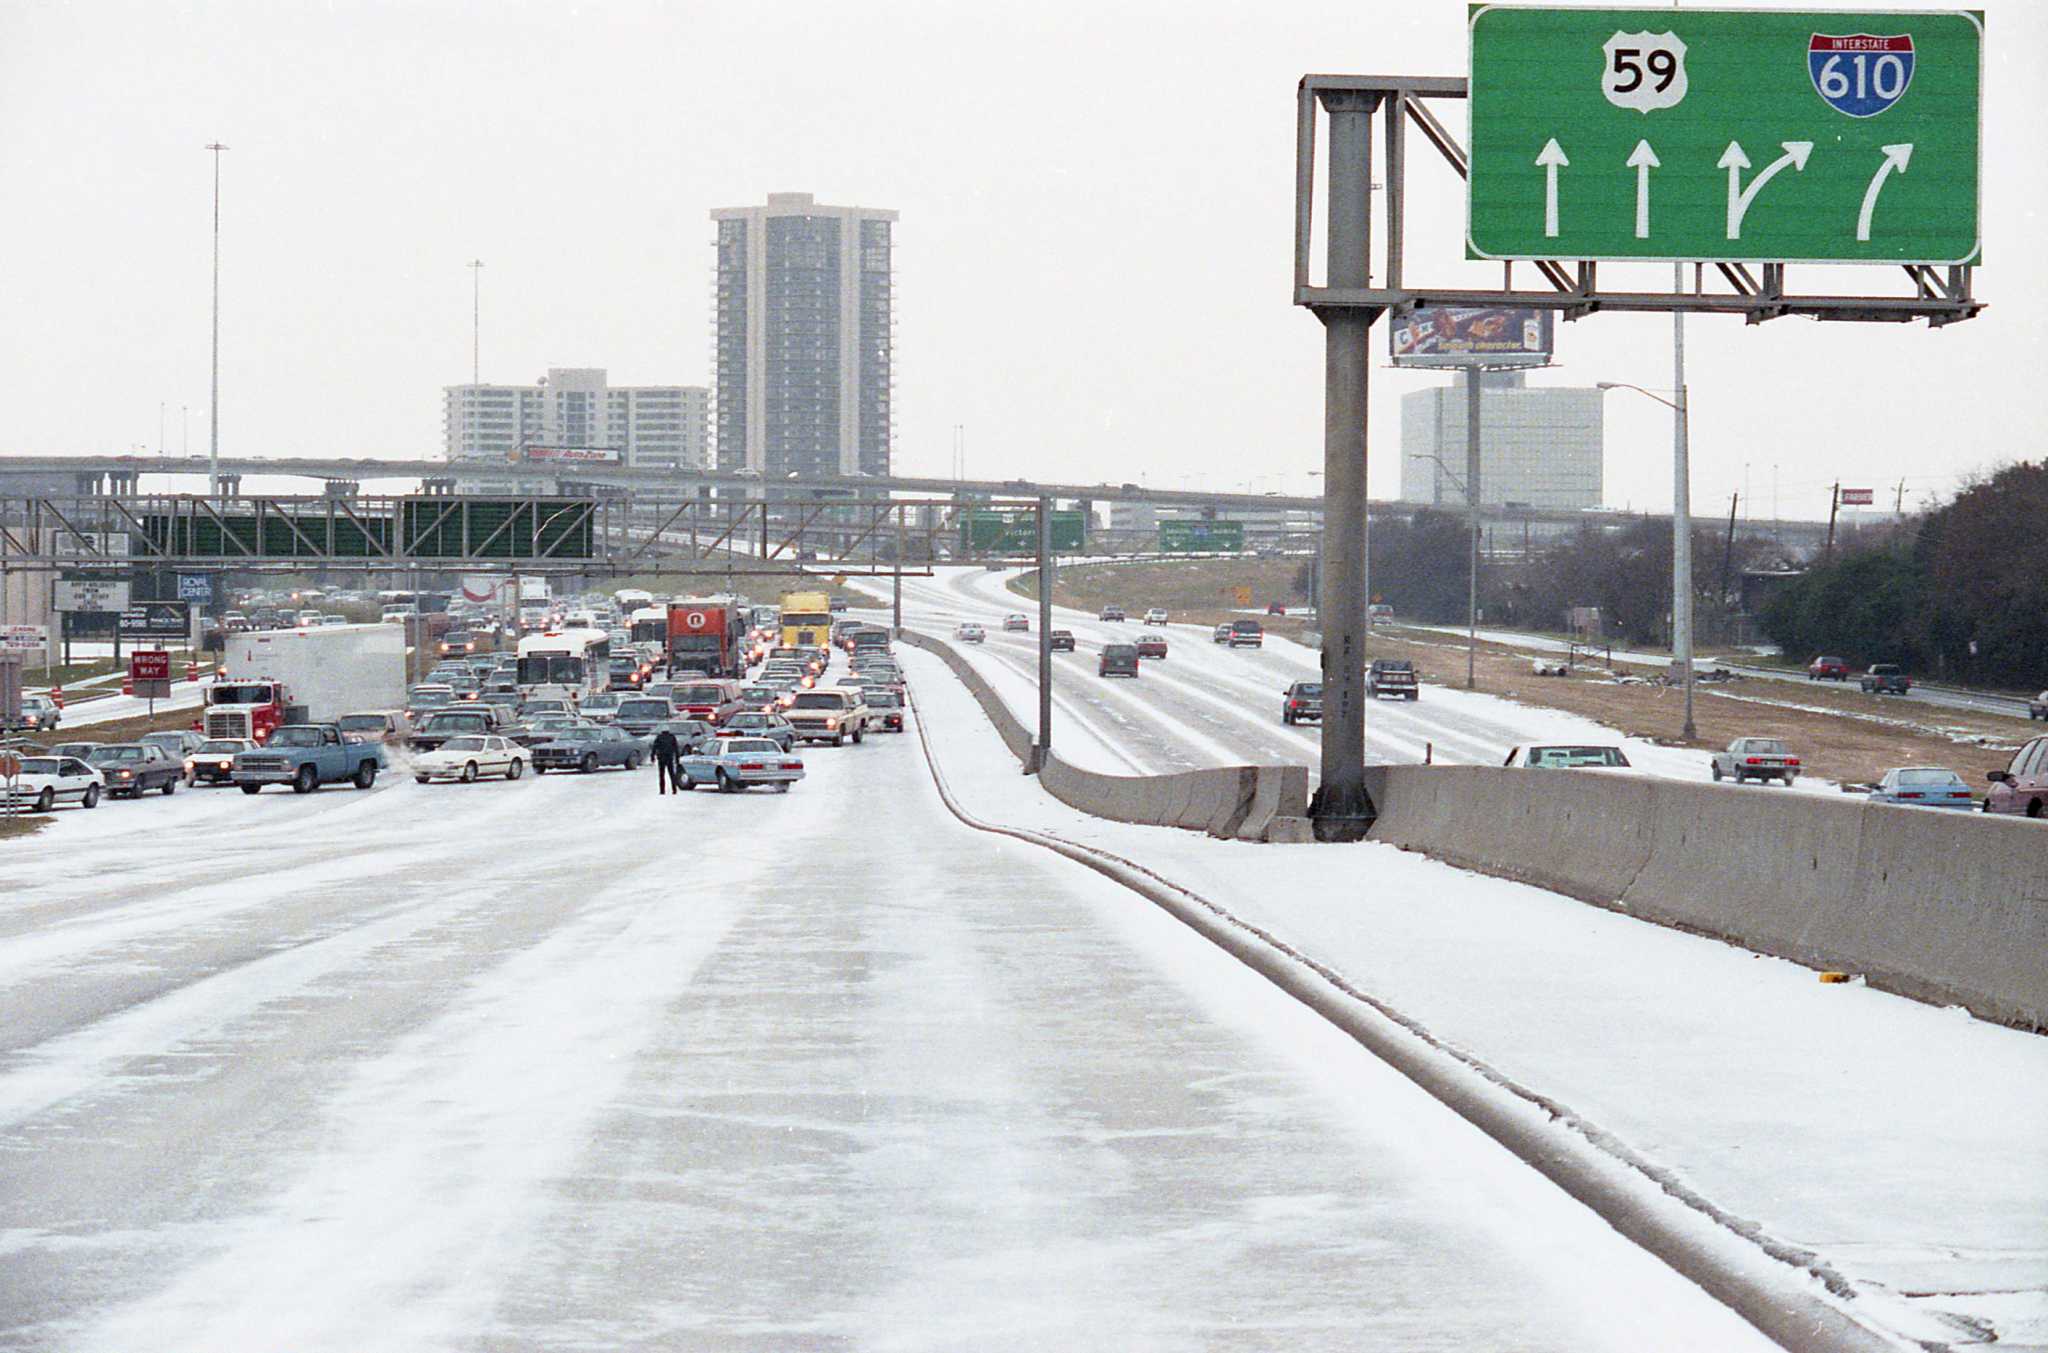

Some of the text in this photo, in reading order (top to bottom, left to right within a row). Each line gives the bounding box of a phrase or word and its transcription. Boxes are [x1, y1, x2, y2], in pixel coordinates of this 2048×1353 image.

[1831, 38, 1890, 50] INTERSTATE
[1613, 49, 1677, 94] 59
[1819, 54, 1905, 100] 610
[133, 655, 167, 664] WRONG
[139, 666, 161, 675] WAY
